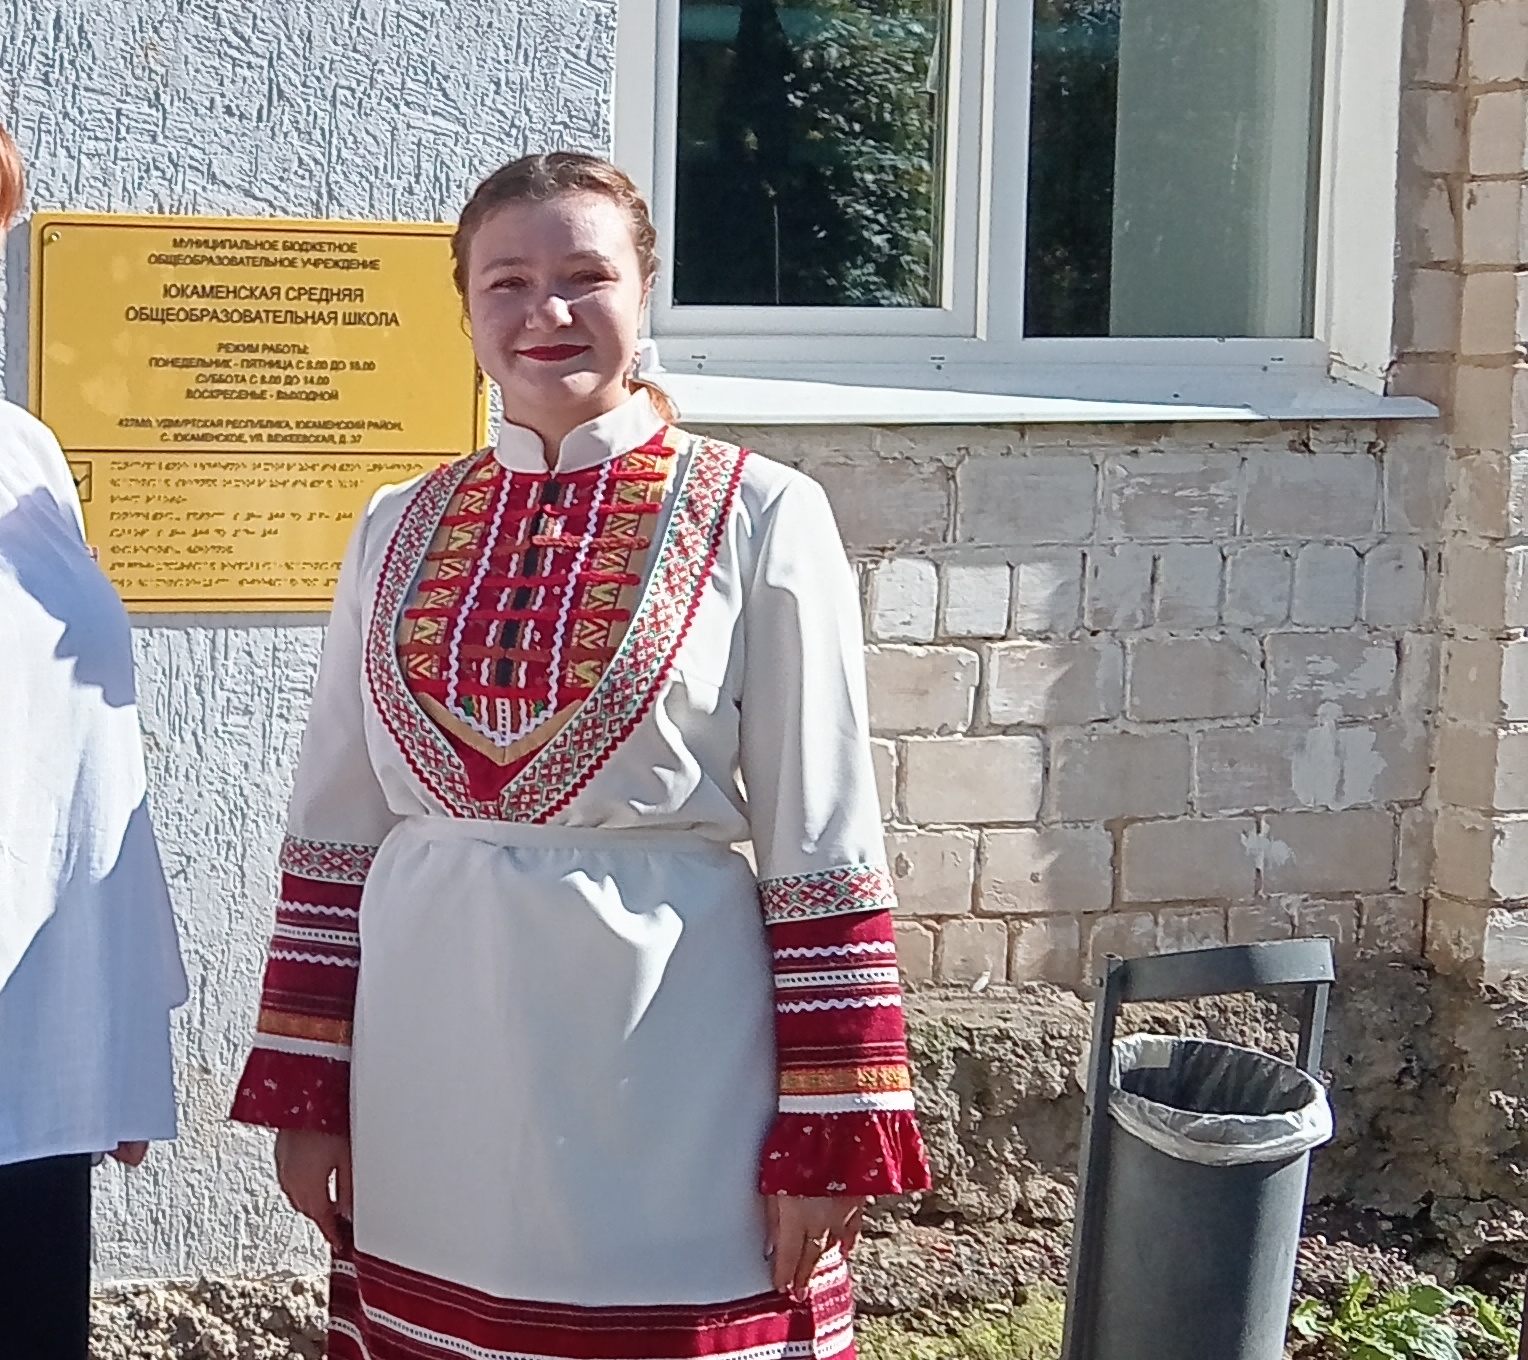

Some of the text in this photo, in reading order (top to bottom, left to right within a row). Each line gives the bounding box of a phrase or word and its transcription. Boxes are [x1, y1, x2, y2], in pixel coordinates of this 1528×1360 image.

[172, 238, 358, 253] МУНИЦИПАЛЬНОЕ БЮДЖЕТНОЕ
[147, 253, 381, 271] ОБЩЕОБРАЗОВАТЕЛЬНОЕ УЧРЕЖДЕНИЕ
[162, 284, 364, 304] ЮКАМЕНСКАЯ СРЕДНЯЯ
[125, 305, 400, 327] ОБЩЕОБРАЗОВАТЕЛЬНАЯ ШКОЛА
[217, 342, 310, 354] РЕЖИМ РАБОТЫ:
[149, 357, 232, 370] ПОНЕДЕЛЬНИК
[240, 359, 294, 372] ПЯТНИЦА
[295, 360, 305, 370] С
[330, 360, 347, 372] ДО
[195, 373, 246, 385] СУББОТА
[249, 374, 258, 385] С
[283, 375, 300, 387] ДО
[185, 388, 267, 400] ВОСКРЕСЕНЬЕ
[276, 388, 339, 401] ВЫХОДНОЙ
